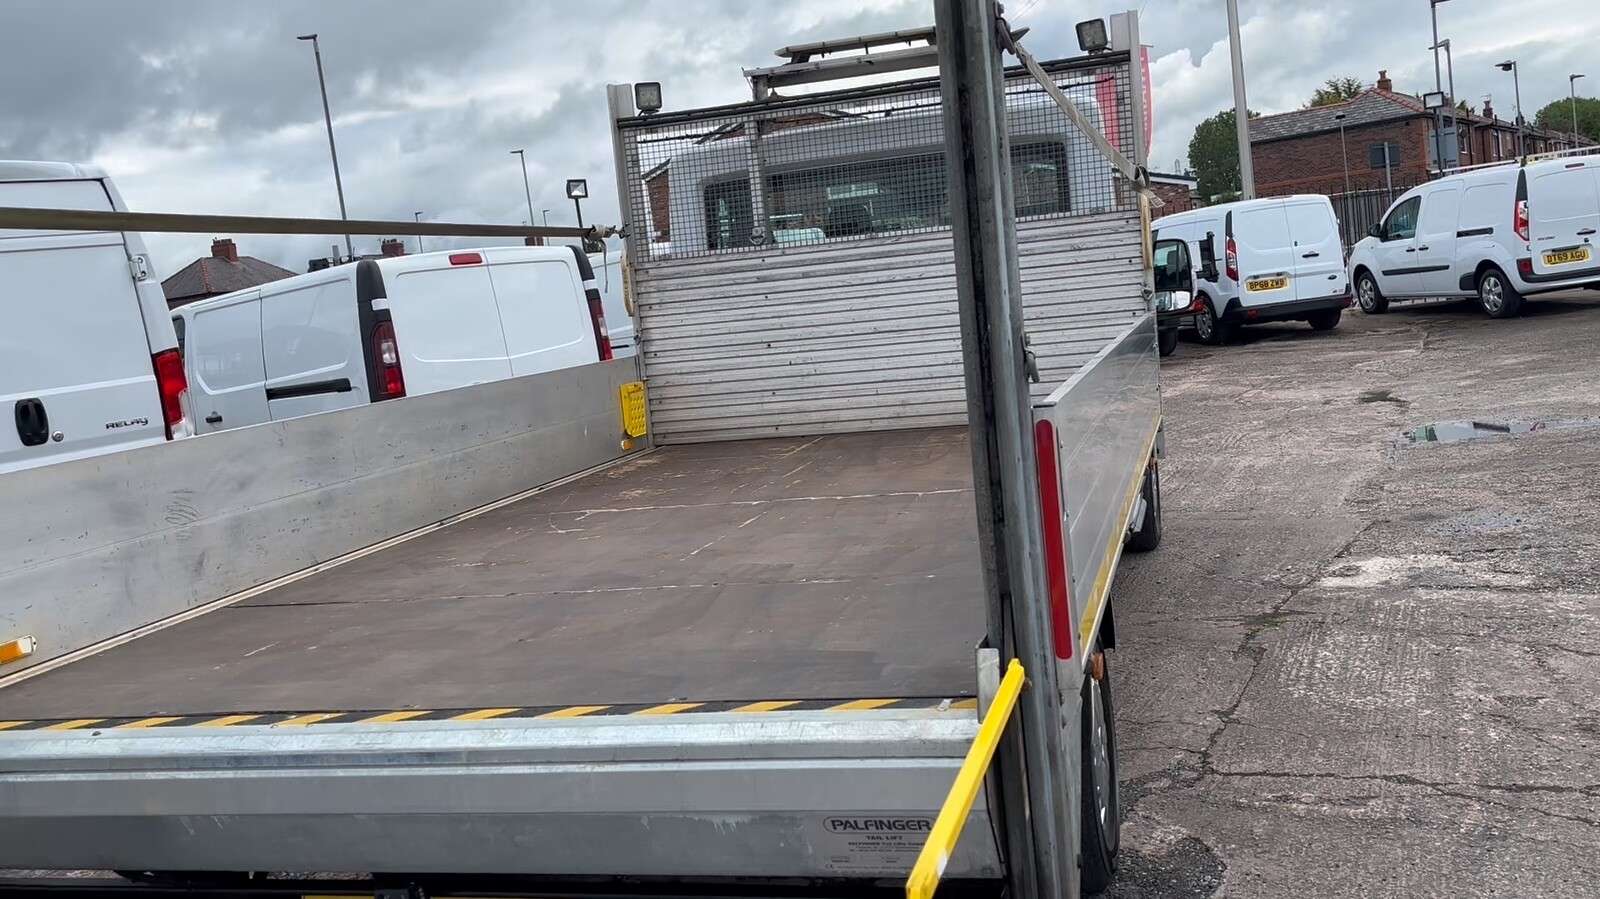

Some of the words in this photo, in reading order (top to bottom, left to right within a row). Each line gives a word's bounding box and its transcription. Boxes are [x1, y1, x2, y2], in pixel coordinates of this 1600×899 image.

[1547, 252, 1569, 263] DT69
[1570, 249, 1586, 260] AGU
[106, 417, 149, 429] RELAY
[831, 819, 932, 831] PALFINGER
